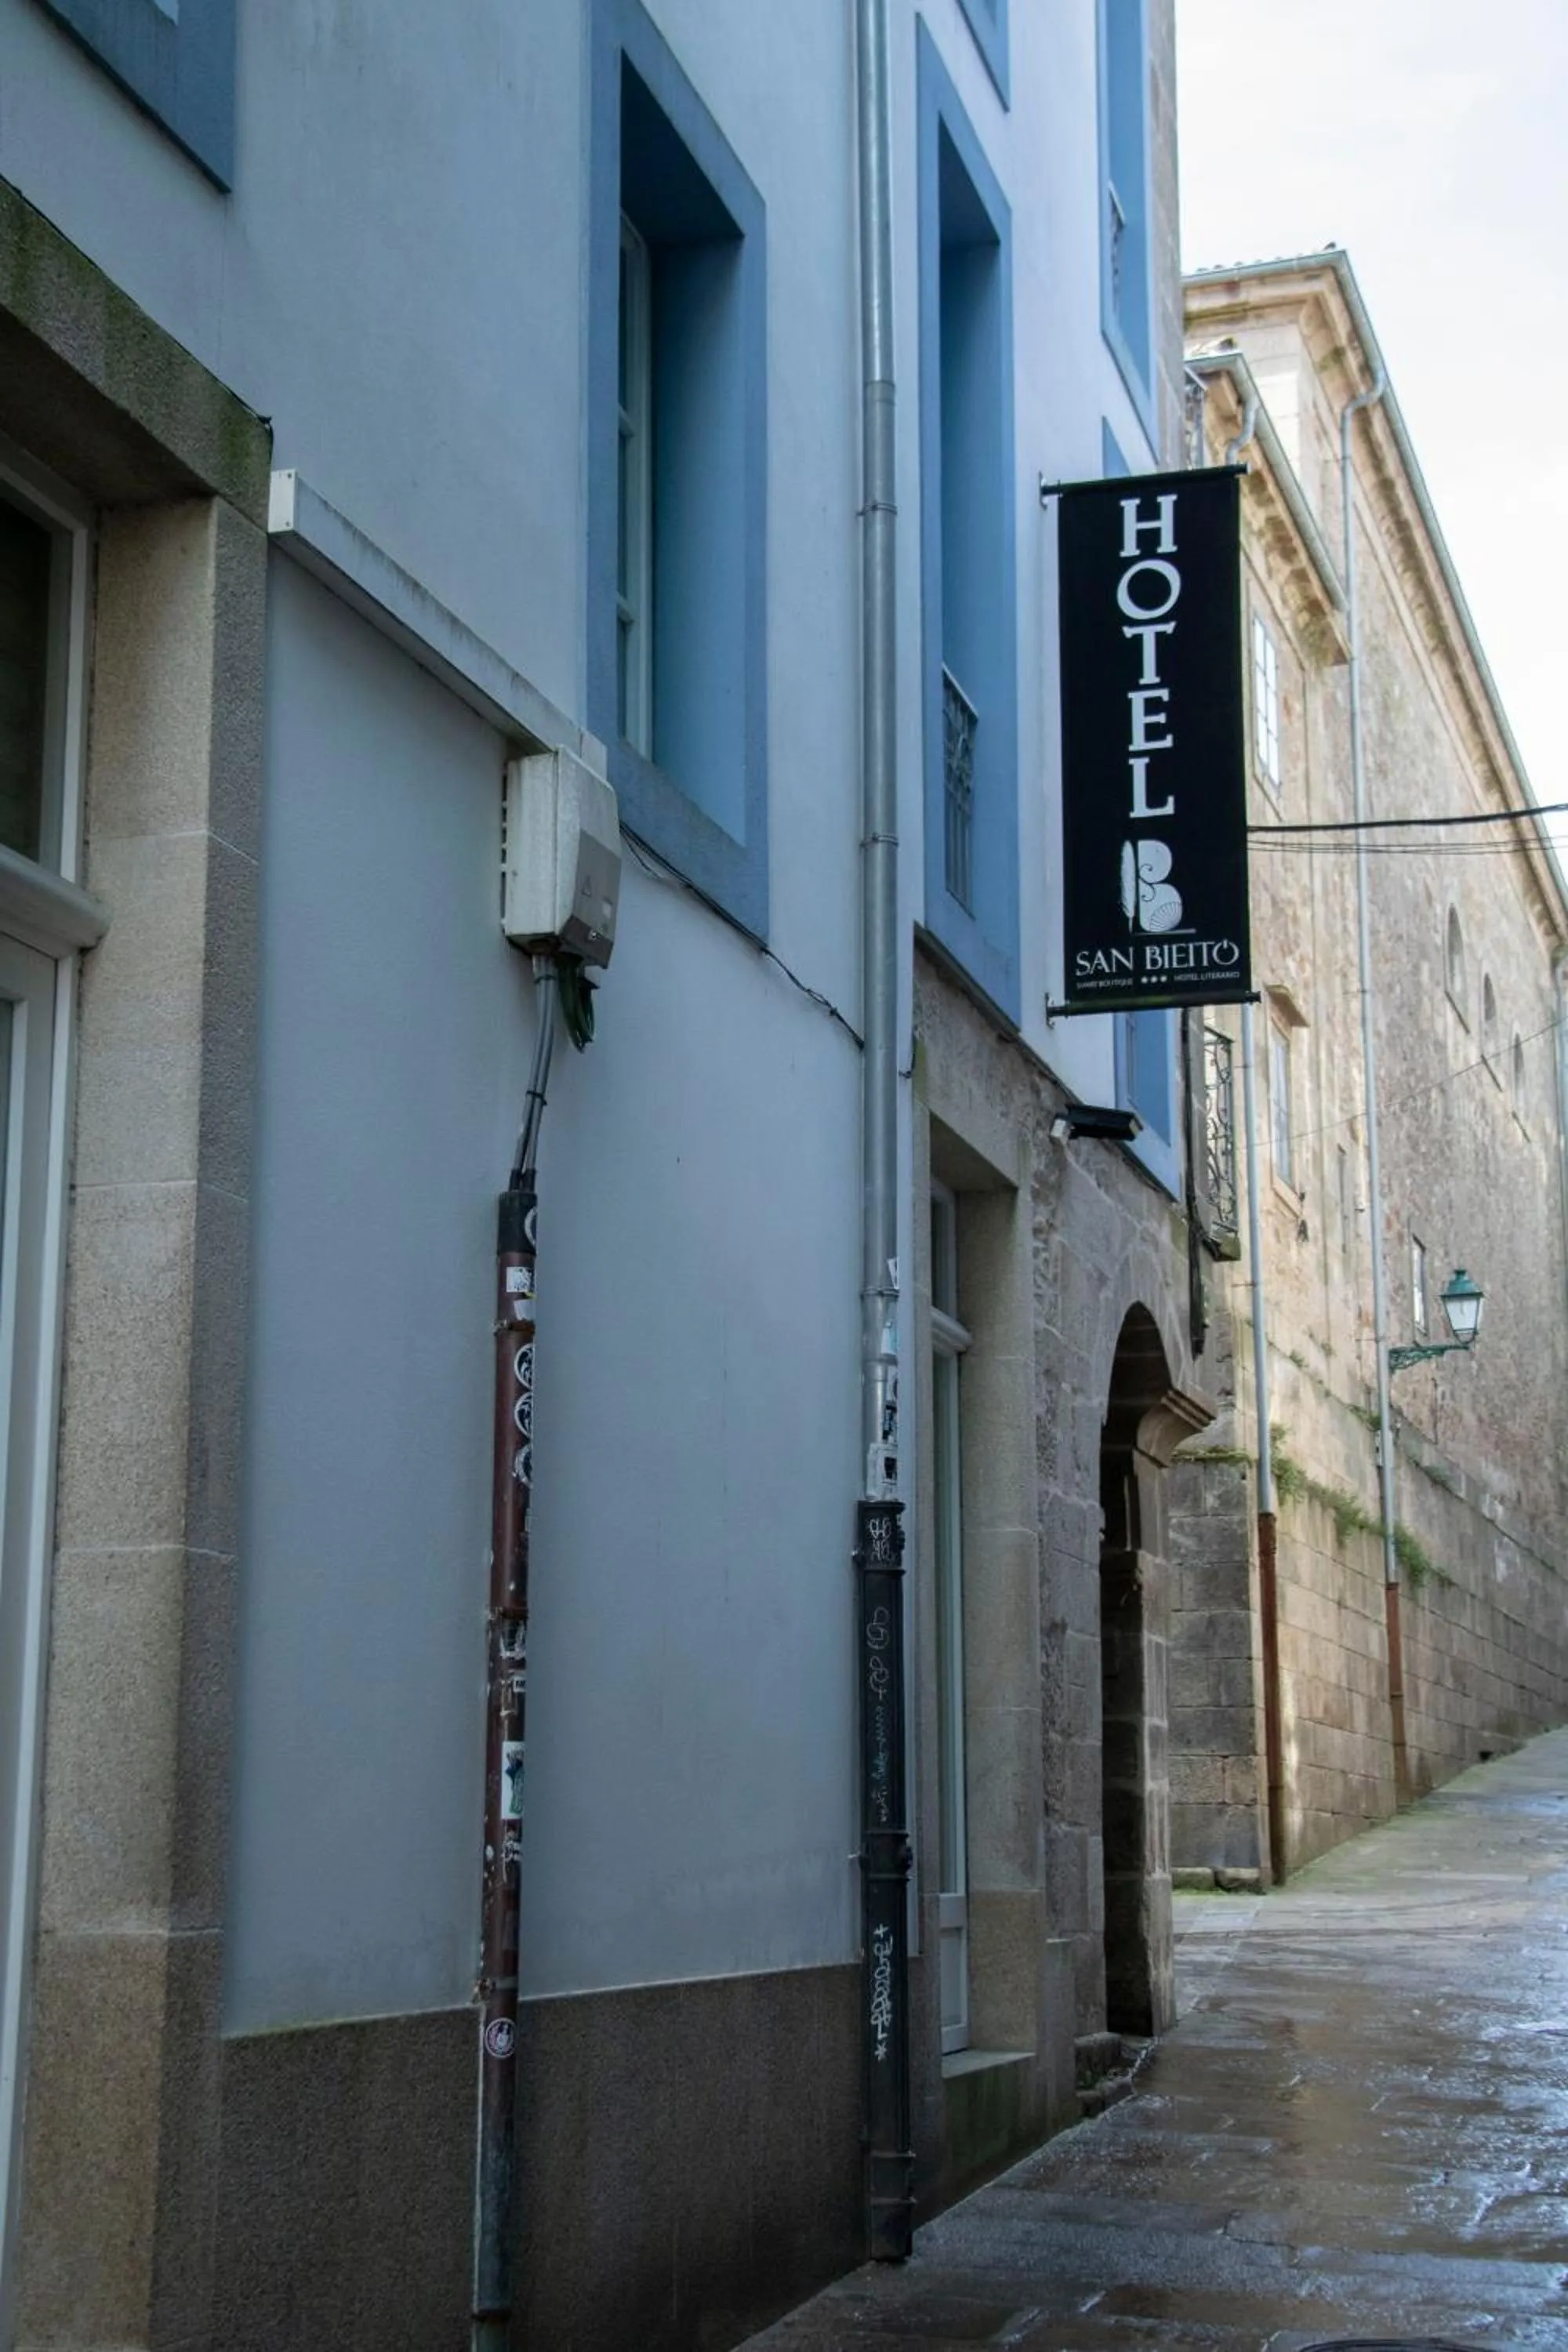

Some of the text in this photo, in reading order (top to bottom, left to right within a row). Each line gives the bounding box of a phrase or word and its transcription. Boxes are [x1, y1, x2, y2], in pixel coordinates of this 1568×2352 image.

[1116, 493, 1181, 818] HOTEL
[1075, 938, 1240, 977] SAN BIEITO
